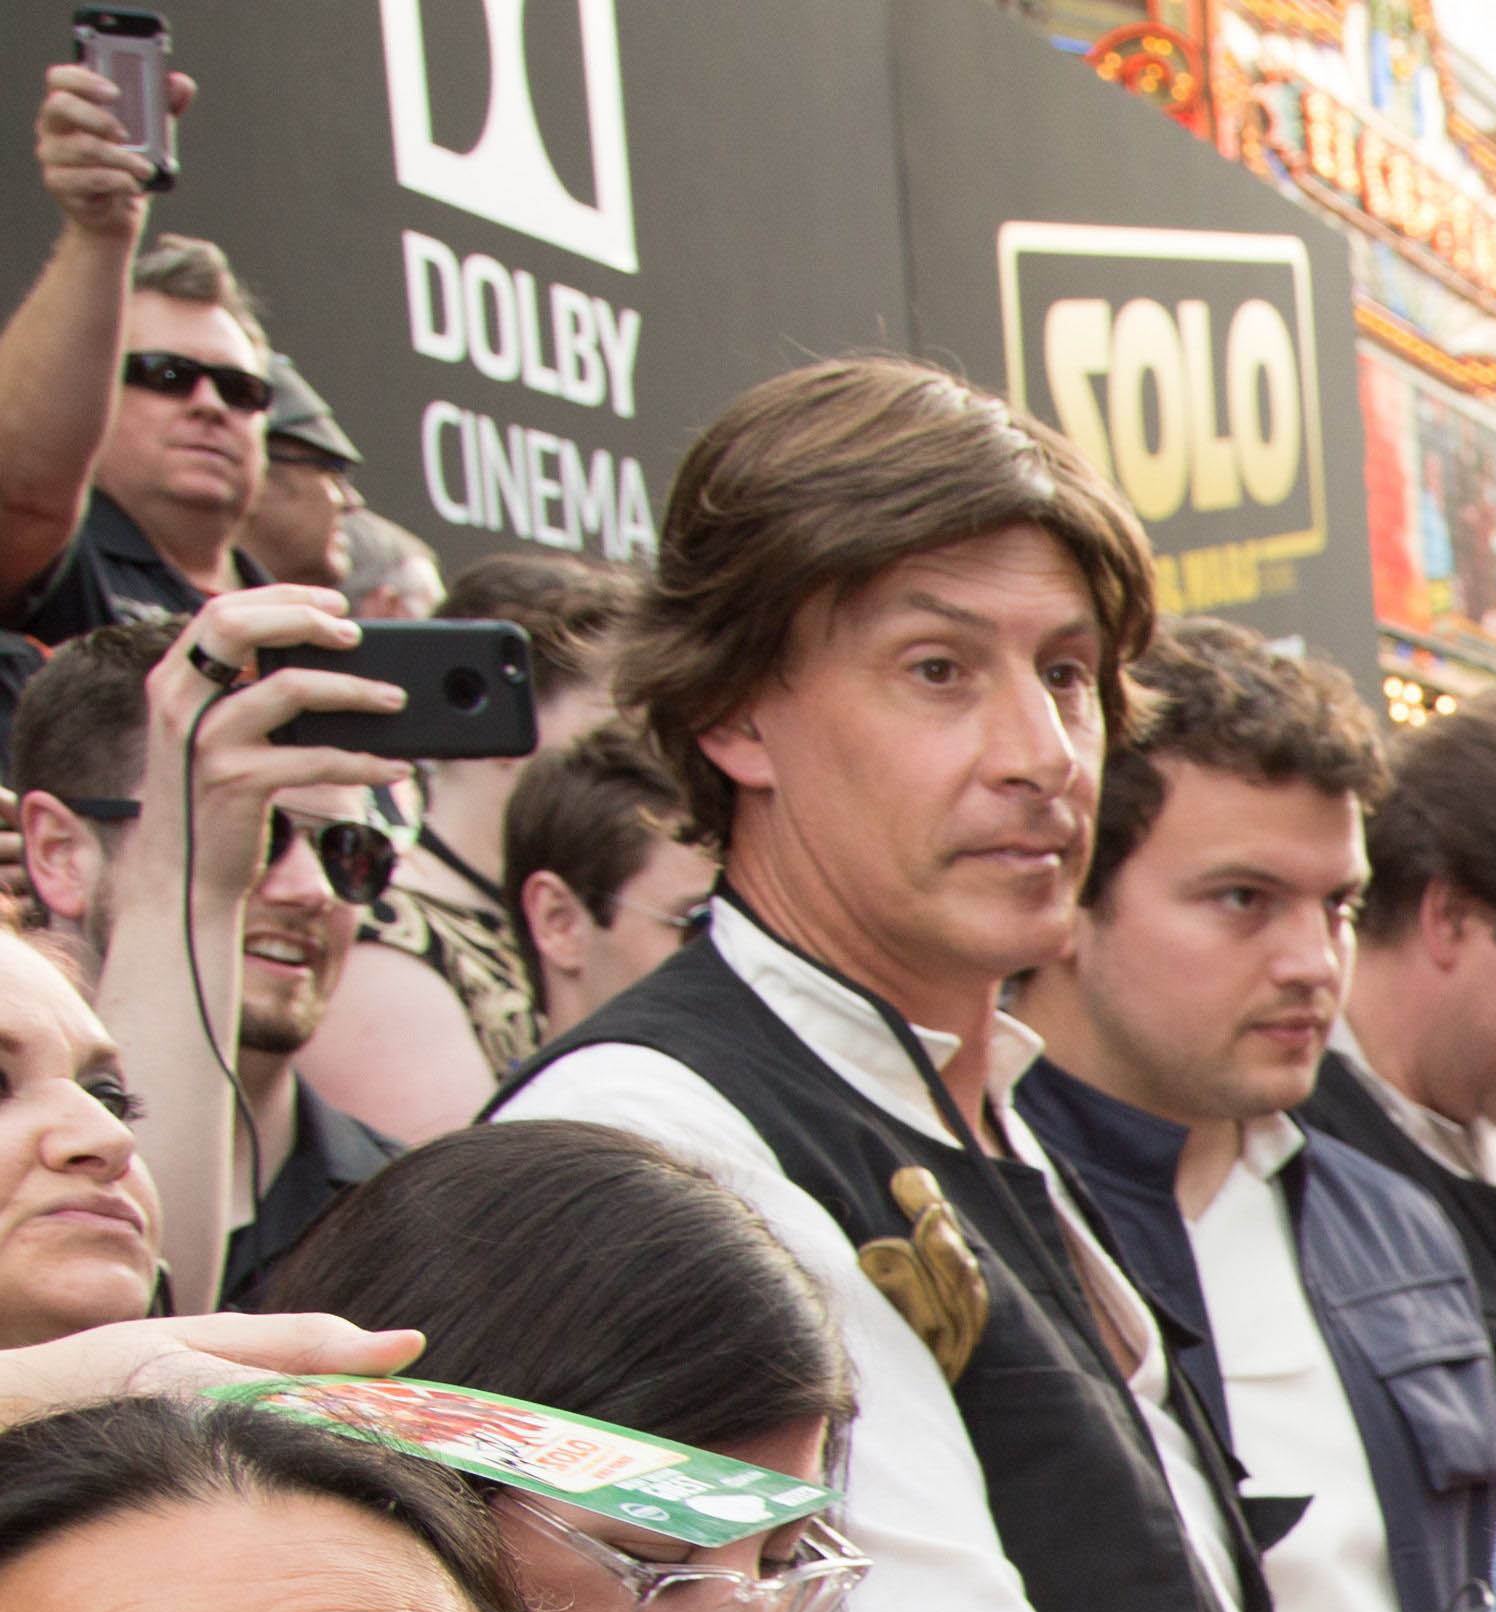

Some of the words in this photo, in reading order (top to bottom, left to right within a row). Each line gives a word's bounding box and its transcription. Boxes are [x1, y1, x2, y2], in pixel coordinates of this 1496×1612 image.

[403, 229, 641, 419] DOLBY
[1044, 298, 1300, 523] SOLO
[422, 400, 660, 570] CINEMA
[537, 1439, 598, 1472] SOLO
